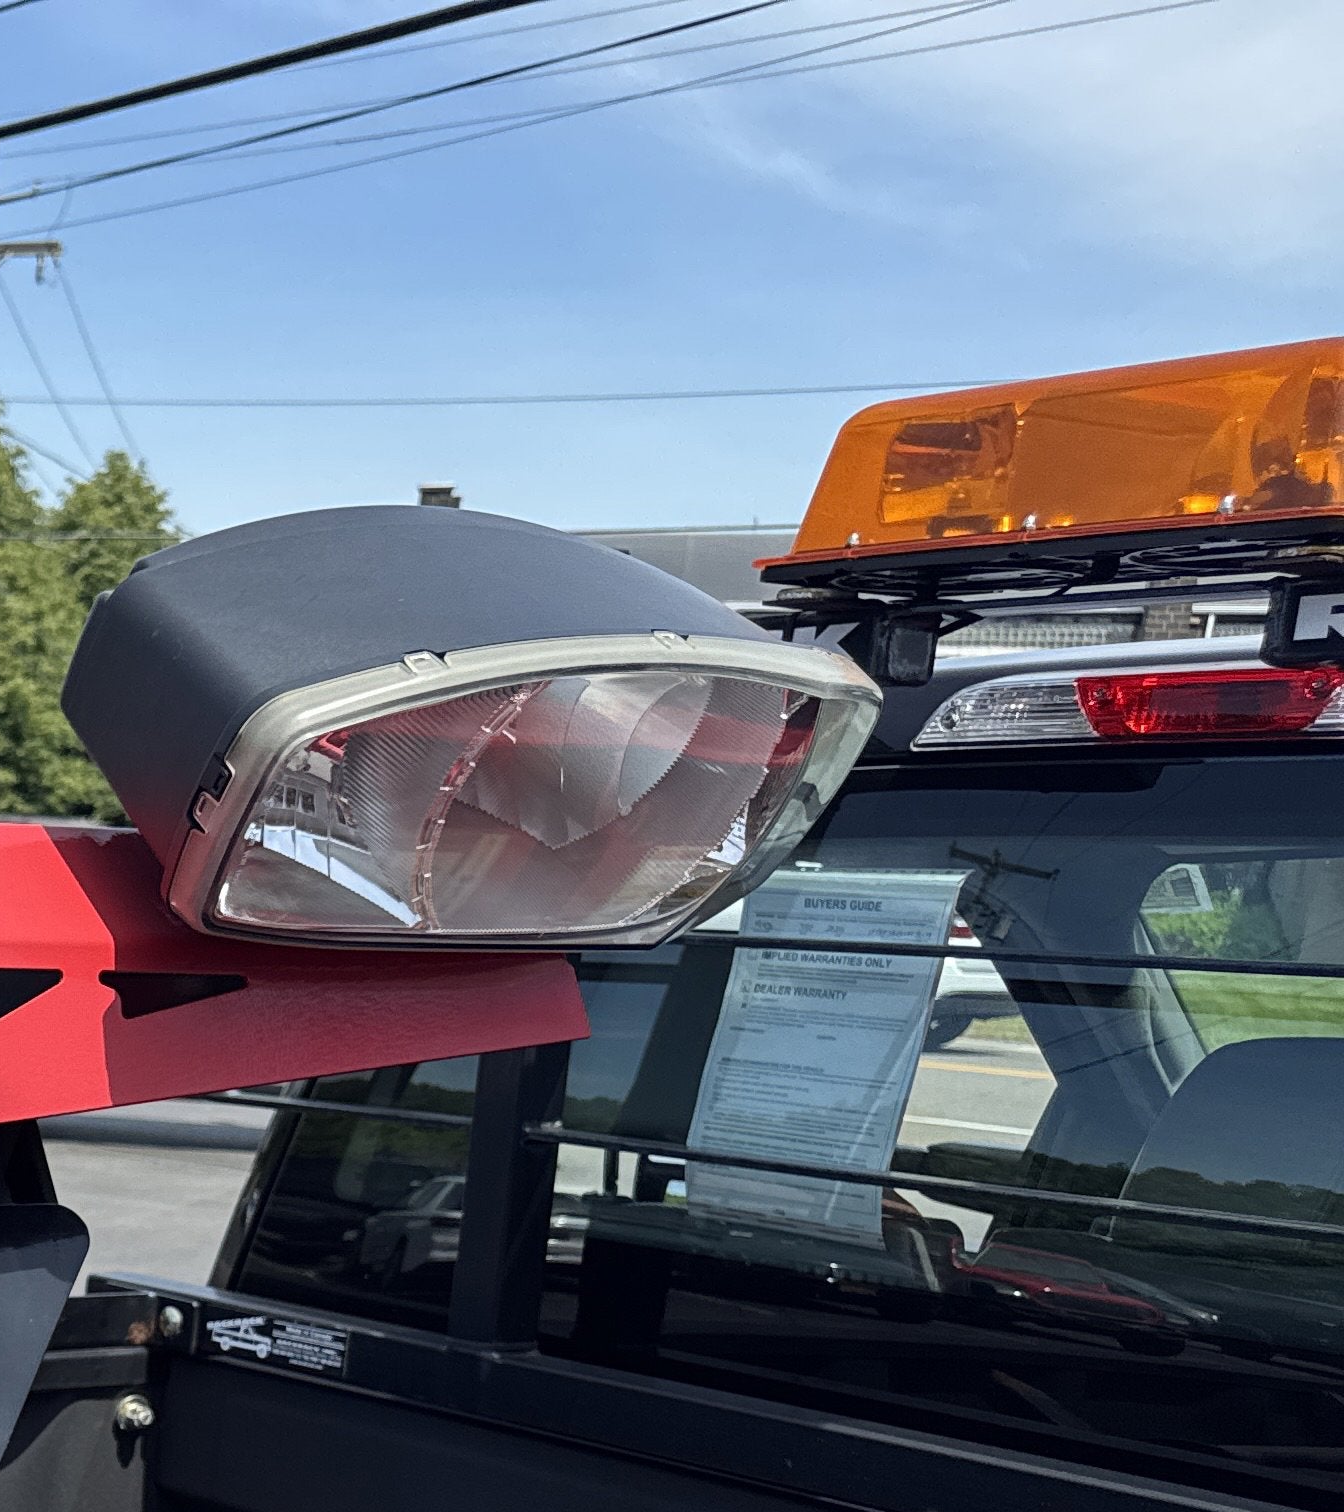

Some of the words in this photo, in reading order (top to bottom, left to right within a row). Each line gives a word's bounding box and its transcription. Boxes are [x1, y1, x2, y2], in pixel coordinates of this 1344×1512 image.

[804, 898, 847, 911] BUYERS
[850, 900, 882, 911] GUIDE
[761, 949, 799, 961] IMPLIED
[800, 952, 863, 967] WARRANTIES
[865, 957, 892, 969] ONLY
[754, 983, 791, 996] DEALER
[793, 986, 847, 1000] WARRANTY
